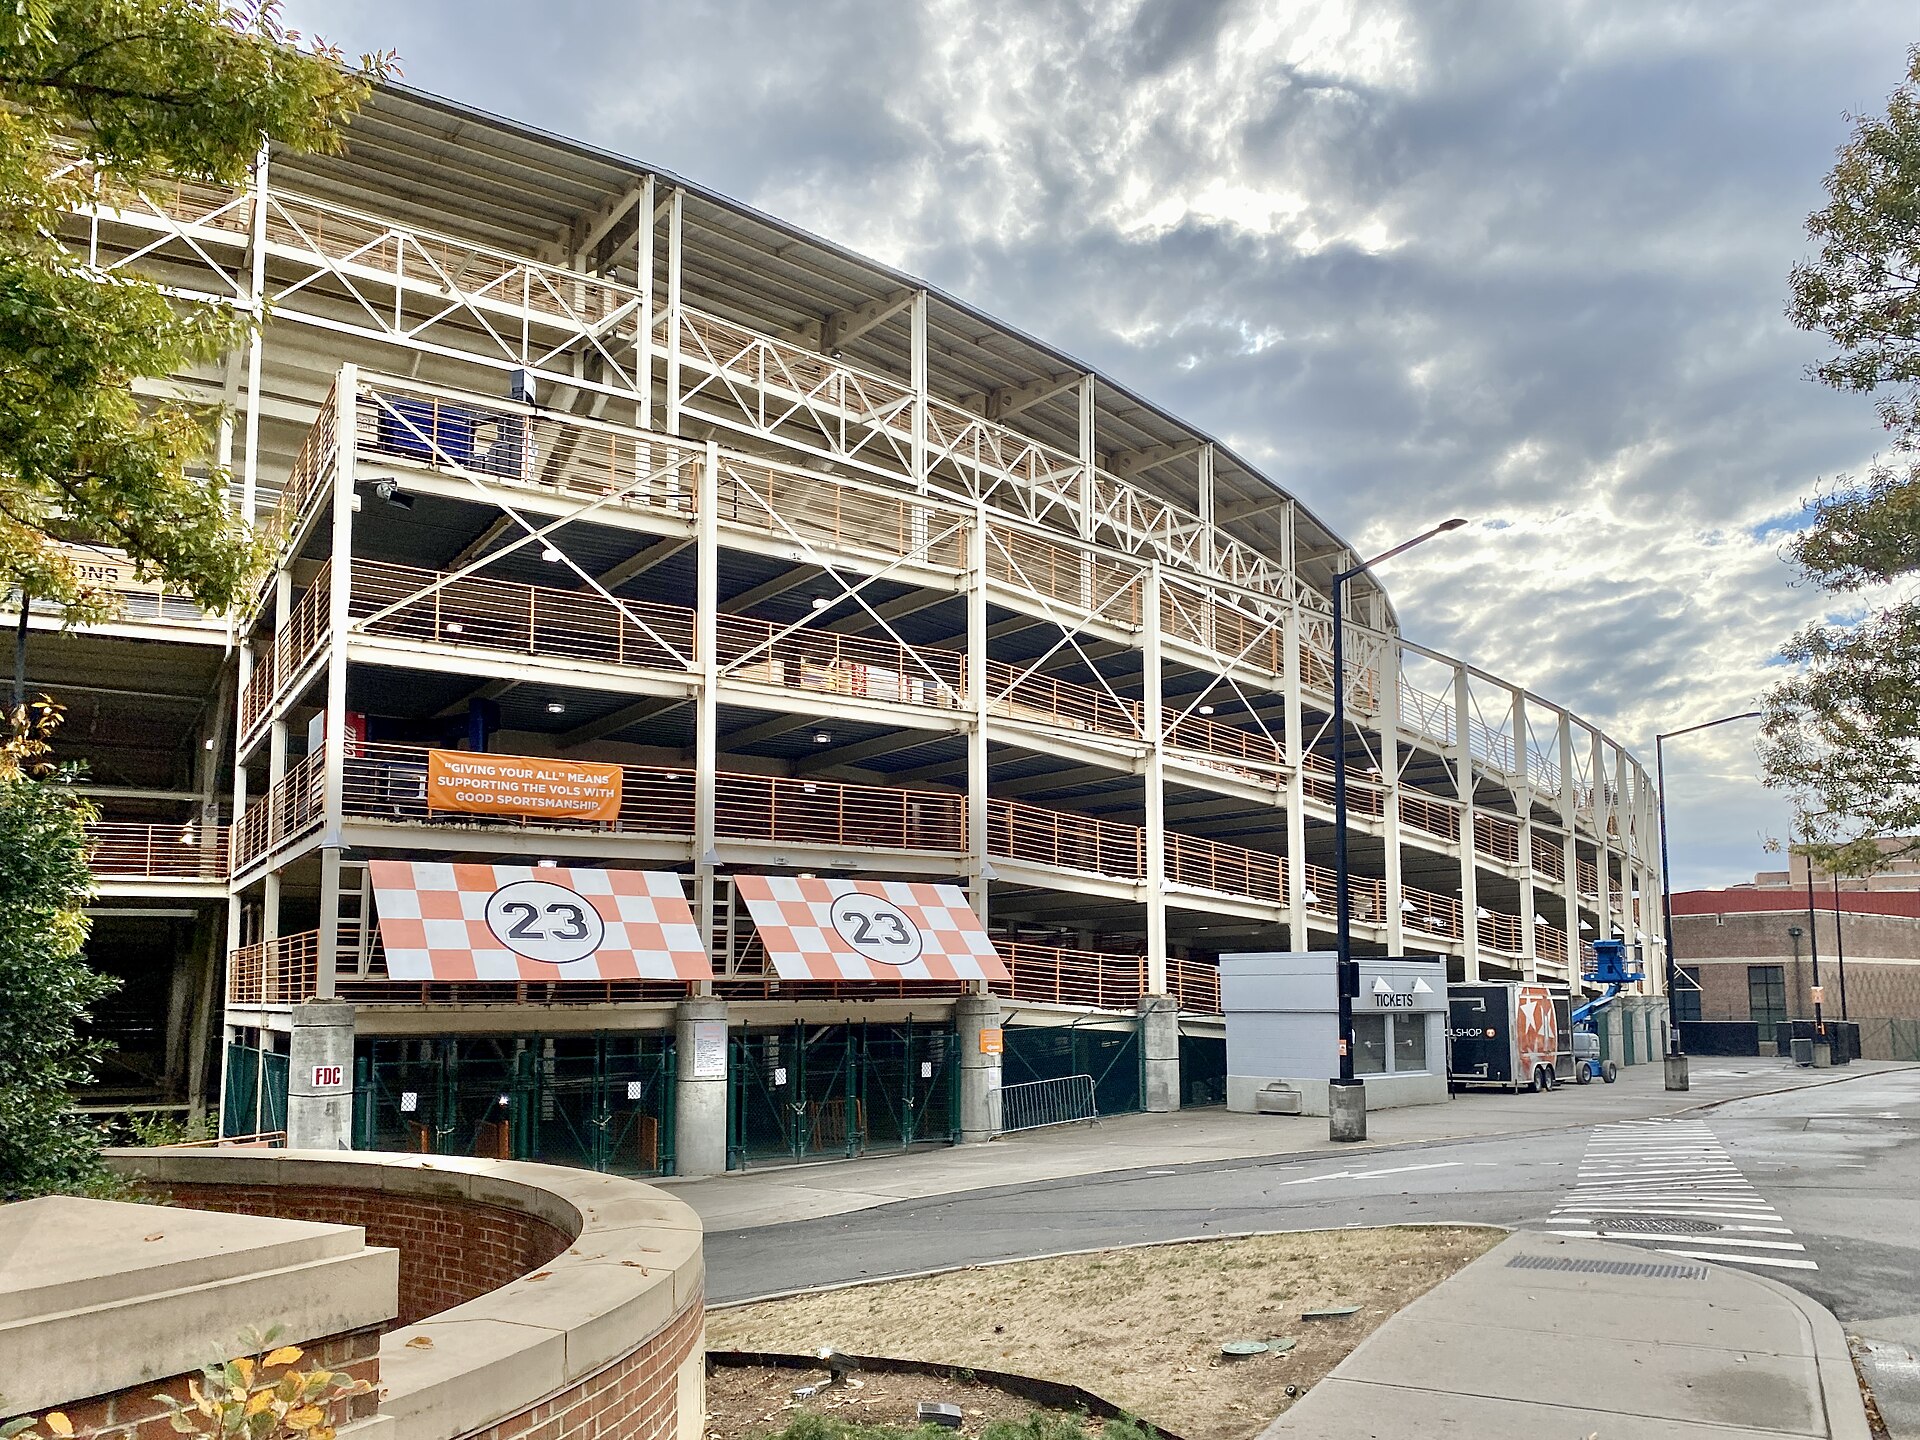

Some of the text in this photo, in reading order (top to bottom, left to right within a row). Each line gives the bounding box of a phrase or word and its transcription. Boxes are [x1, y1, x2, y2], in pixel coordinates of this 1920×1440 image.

[444, 762, 609, 784] “GIVING YOUR ALL” MEANS
[437, 776, 615, 798] SUPPORTING THE VOLS WITH
[455, 791, 601, 811] GOOD SPORTSMANSHIP.
[501, 902, 590, 941] 23
[841, 911, 912, 946] 23
[1375, 993, 1413, 1007] TICKETS
[315, 1067, 341, 1085] FDC
